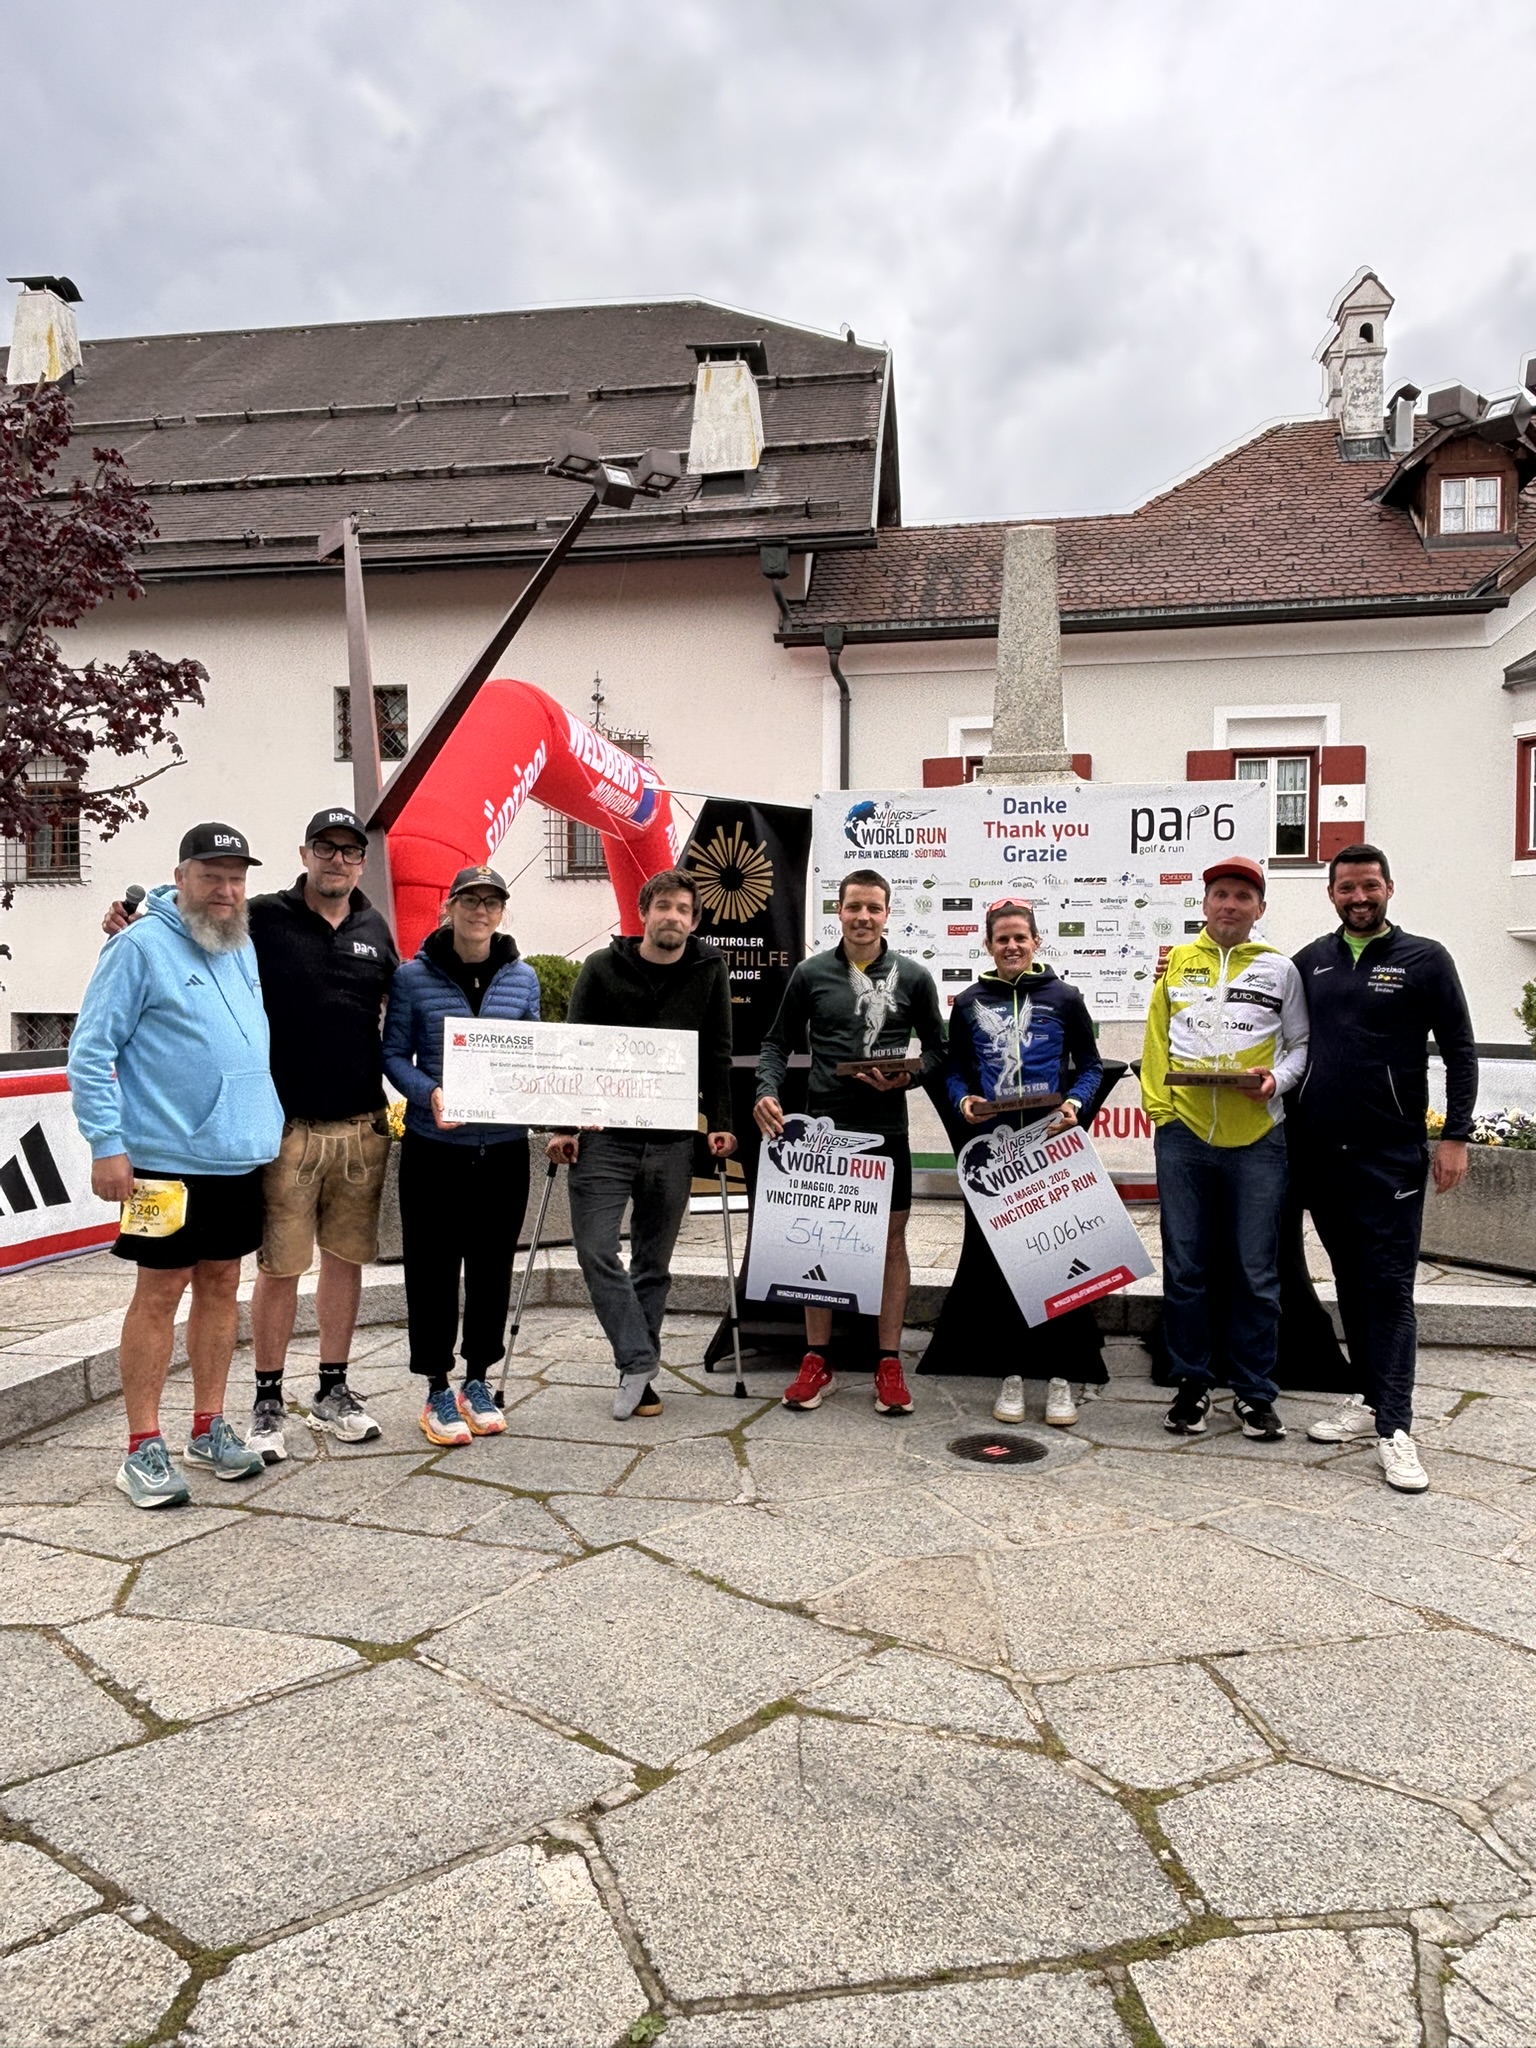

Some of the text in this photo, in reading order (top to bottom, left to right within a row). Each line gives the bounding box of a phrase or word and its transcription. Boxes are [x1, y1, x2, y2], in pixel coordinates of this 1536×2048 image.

[1003, 796, 1067, 815] Danke
[875, 810, 913, 821] WINGS
[880, 820, 900, 828] LIFE
[861, 827, 947, 845] WORLD RUN
[984, 820, 1089, 842] Thank you
[844, 850, 857, 859] APP
[858, 850, 871, 859] RUN
[873, 849, 909, 859] WELSBERG
[914, 848, 947, 858] SÜDTIROL
[1003, 844, 1067, 862] Grazie
[1139, 844, 1158, 855] golf
[1160, 845, 1165, 853] &
[729, 971, 761, 980] ADIGE
[468, 1034, 534, 1046] SPARKASSE
[448, 1108, 496, 1119] FAC SIMILE
[1094, 1107, 1152, 1138] RUN
[804, 1133, 848, 1147] WINGS
[810, 1143, 834, 1155] LIFE
[993, 1131, 1032, 1157] WINGS
[986, 1132, 1085, 1191] WORLD RUN
[1004, 1147, 1025, 1165] LIFE
[787, 1151, 886, 1180] WORLD RUN
[789, 1179, 798, 1188] 10
[838, 1184, 860, 1195] 2026
[1003, 1194, 1013, 1207] 10
[1049, 1168, 1071, 1186] 2026
[130, 1204, 159, 1216] 3240
[766, 1190, 878, 1215] VINCITORE APP RUN
[990, 1172, 1098, 1231] VINCITORE APP RUN
[1026, 1214, 1105, 1255] 40,06 km
